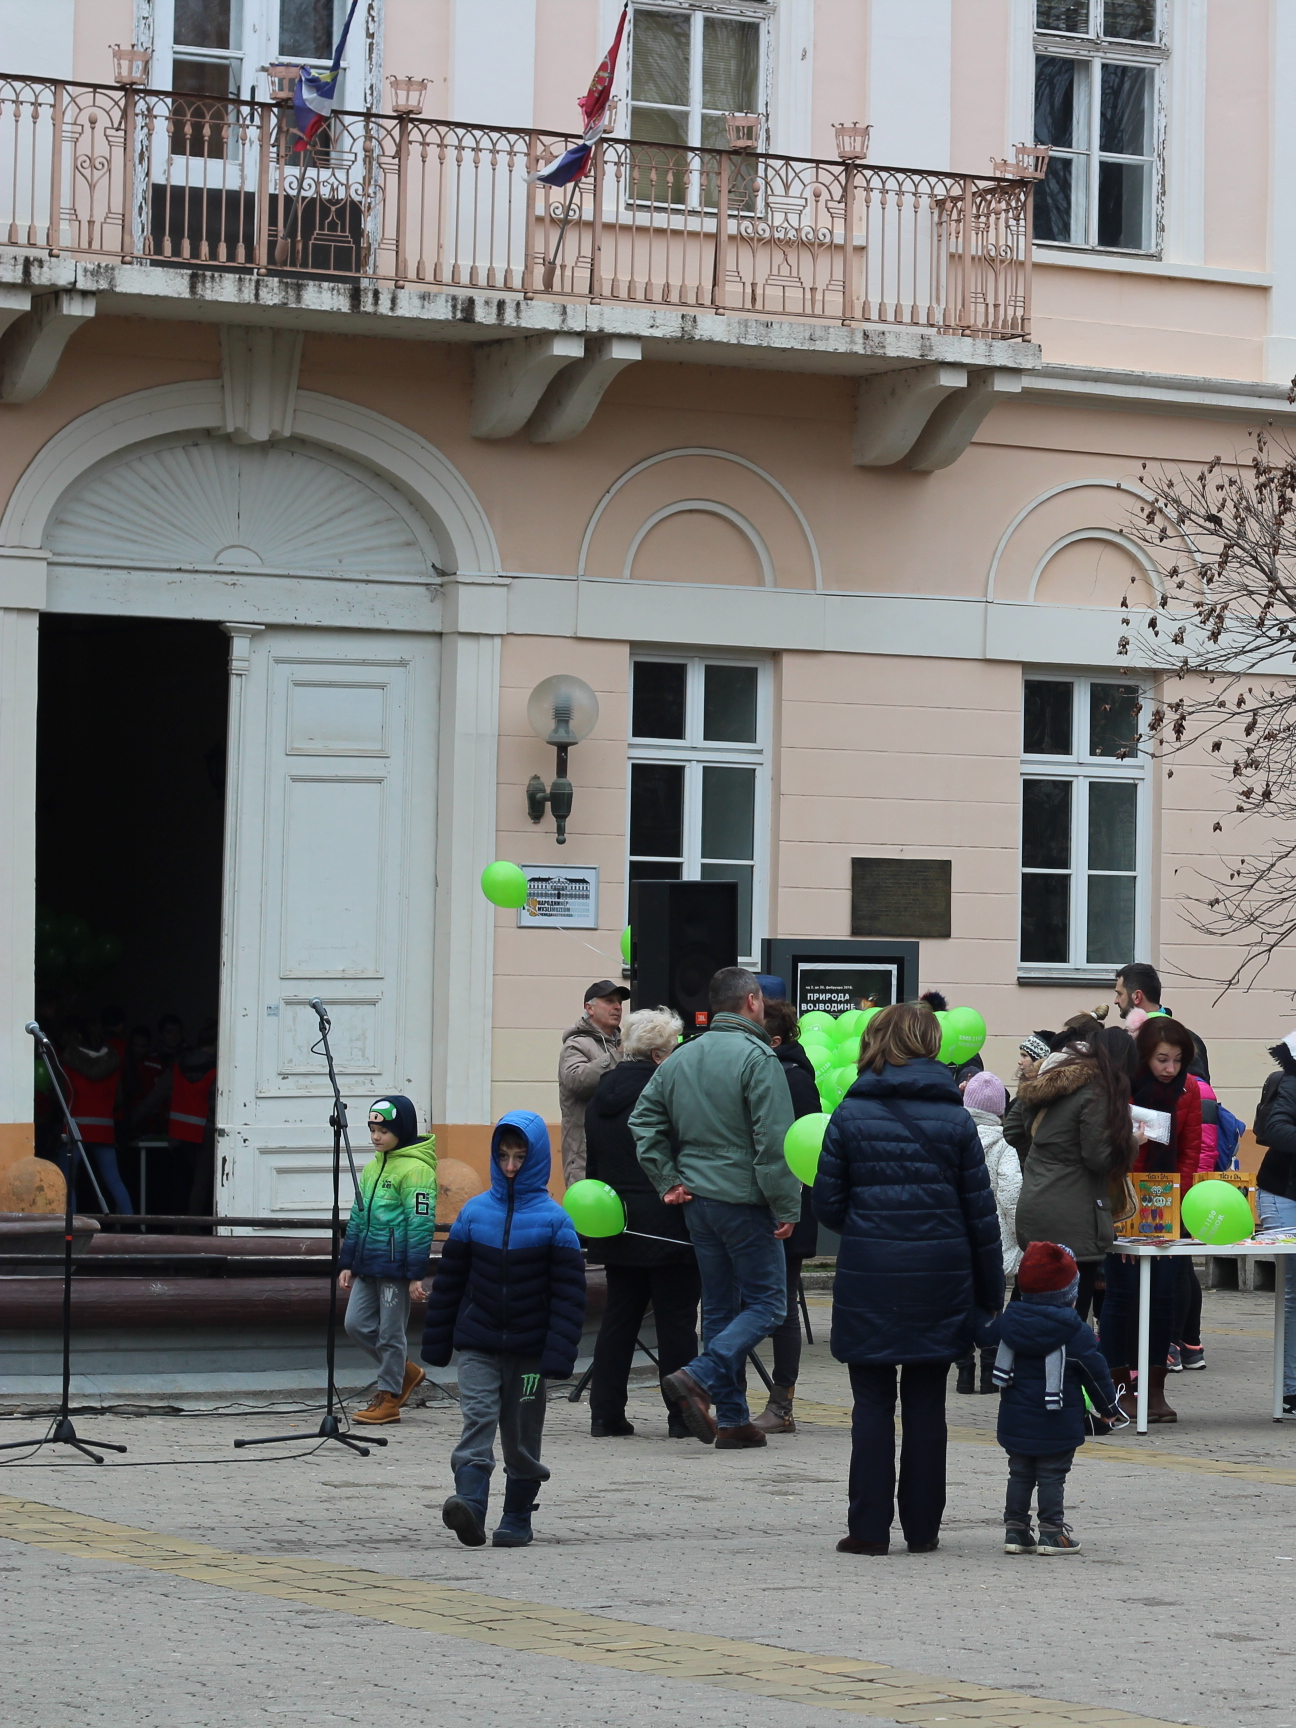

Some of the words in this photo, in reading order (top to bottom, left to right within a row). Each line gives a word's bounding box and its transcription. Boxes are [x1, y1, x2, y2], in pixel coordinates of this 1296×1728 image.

[807, 993, 850, 1002] ПРИРОДА
[801, 1003, 856, 1012] ВОЈВОДИНЕ
[1204, 1210, 1217, 1226] 1150
